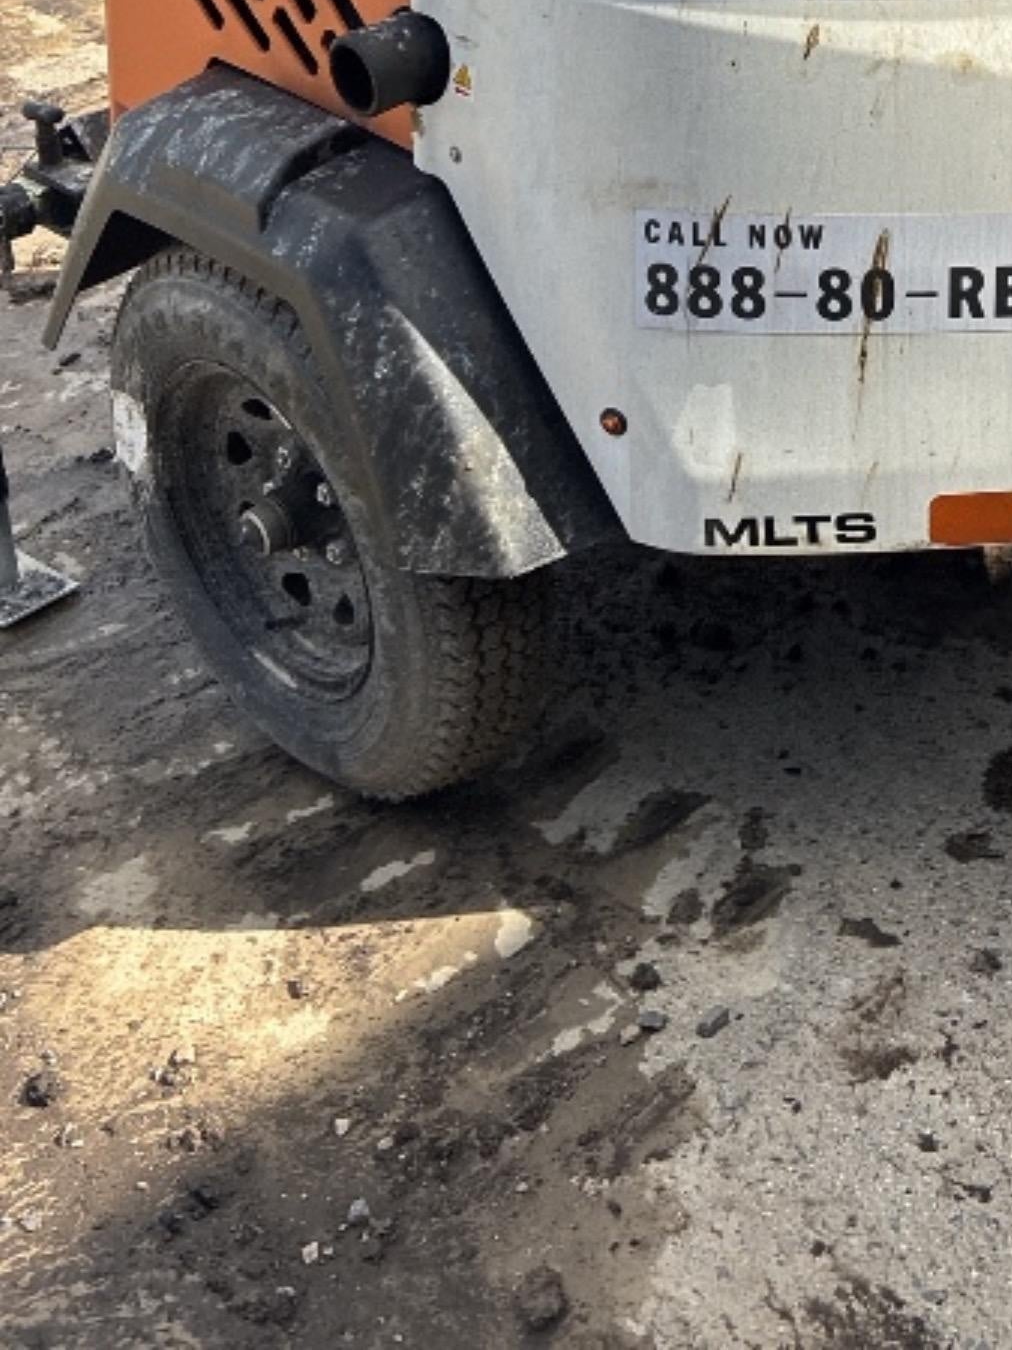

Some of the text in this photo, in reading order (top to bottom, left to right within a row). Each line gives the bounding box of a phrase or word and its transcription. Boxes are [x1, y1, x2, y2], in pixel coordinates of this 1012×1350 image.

[644, 218, 824, 250] CALL NOW
[704, 512, 877, 547] MLTS
